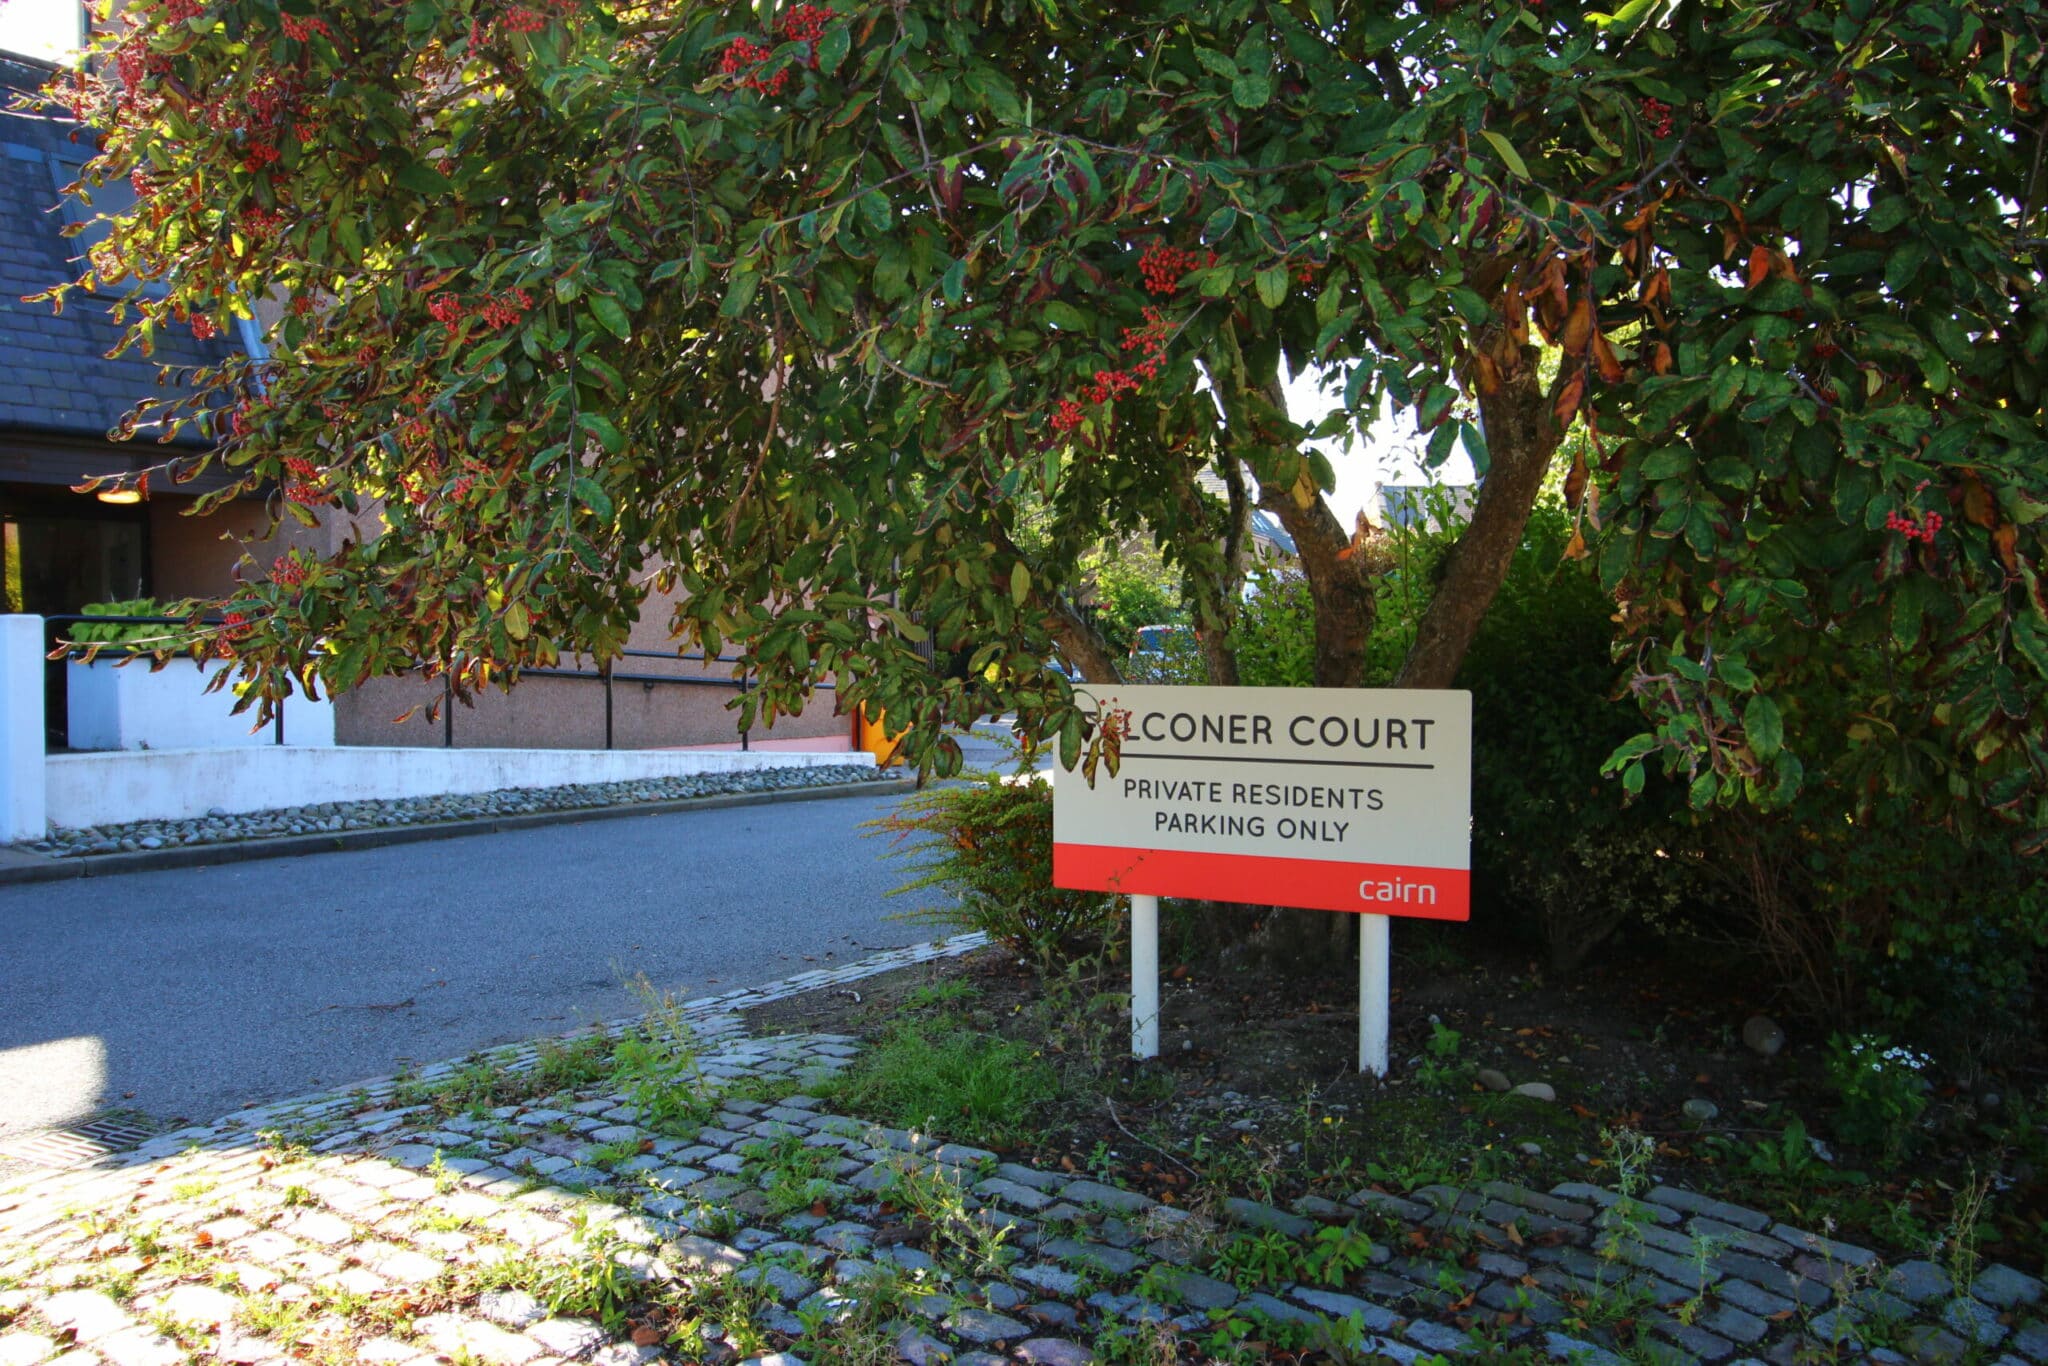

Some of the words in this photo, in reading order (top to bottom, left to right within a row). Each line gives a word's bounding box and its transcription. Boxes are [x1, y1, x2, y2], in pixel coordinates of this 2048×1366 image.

[1082, 710, 1273, 745] LCONER
[1289, 715, 1435, 750] COURT
[1124, 778, 1222, 803] PRIVATE
[1233, 783, 1384, 811] RESIDENTS
[1155, 811, 1265, 838] PARKING
[1277, 818, 1350, 842] ONLY
[1359, 876, 1436, 905] cairn
